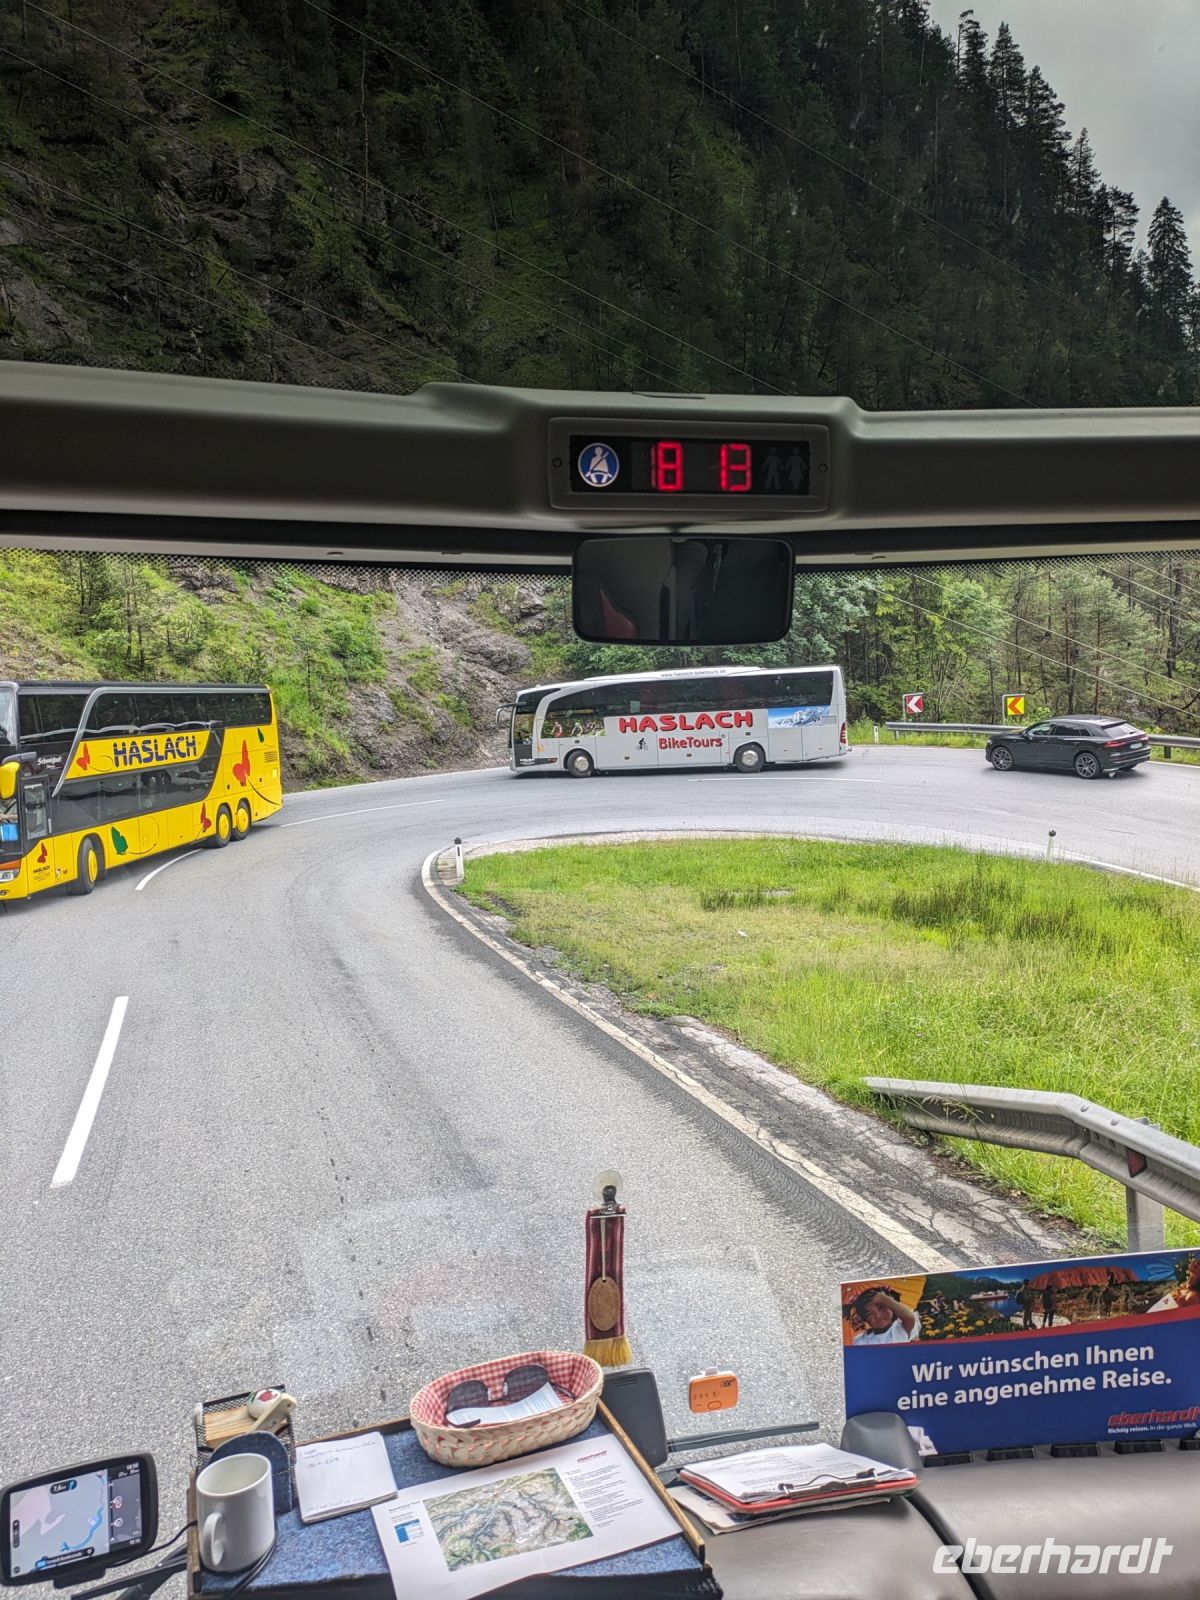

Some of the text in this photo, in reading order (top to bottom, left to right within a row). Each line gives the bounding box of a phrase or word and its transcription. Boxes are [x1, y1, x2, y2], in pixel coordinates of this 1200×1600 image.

[720, 443, 751, 492] 13
[618, 710, 754, 734] HASLACH
[112, 735, 197, 768] HASLACH
[658, 736, 723, 750] BikeTours
[911, 1345, 1155, 1383] Wir wünschen Ihnen
[896, 1367, 1172, 1411] eine angenehme Reise.
